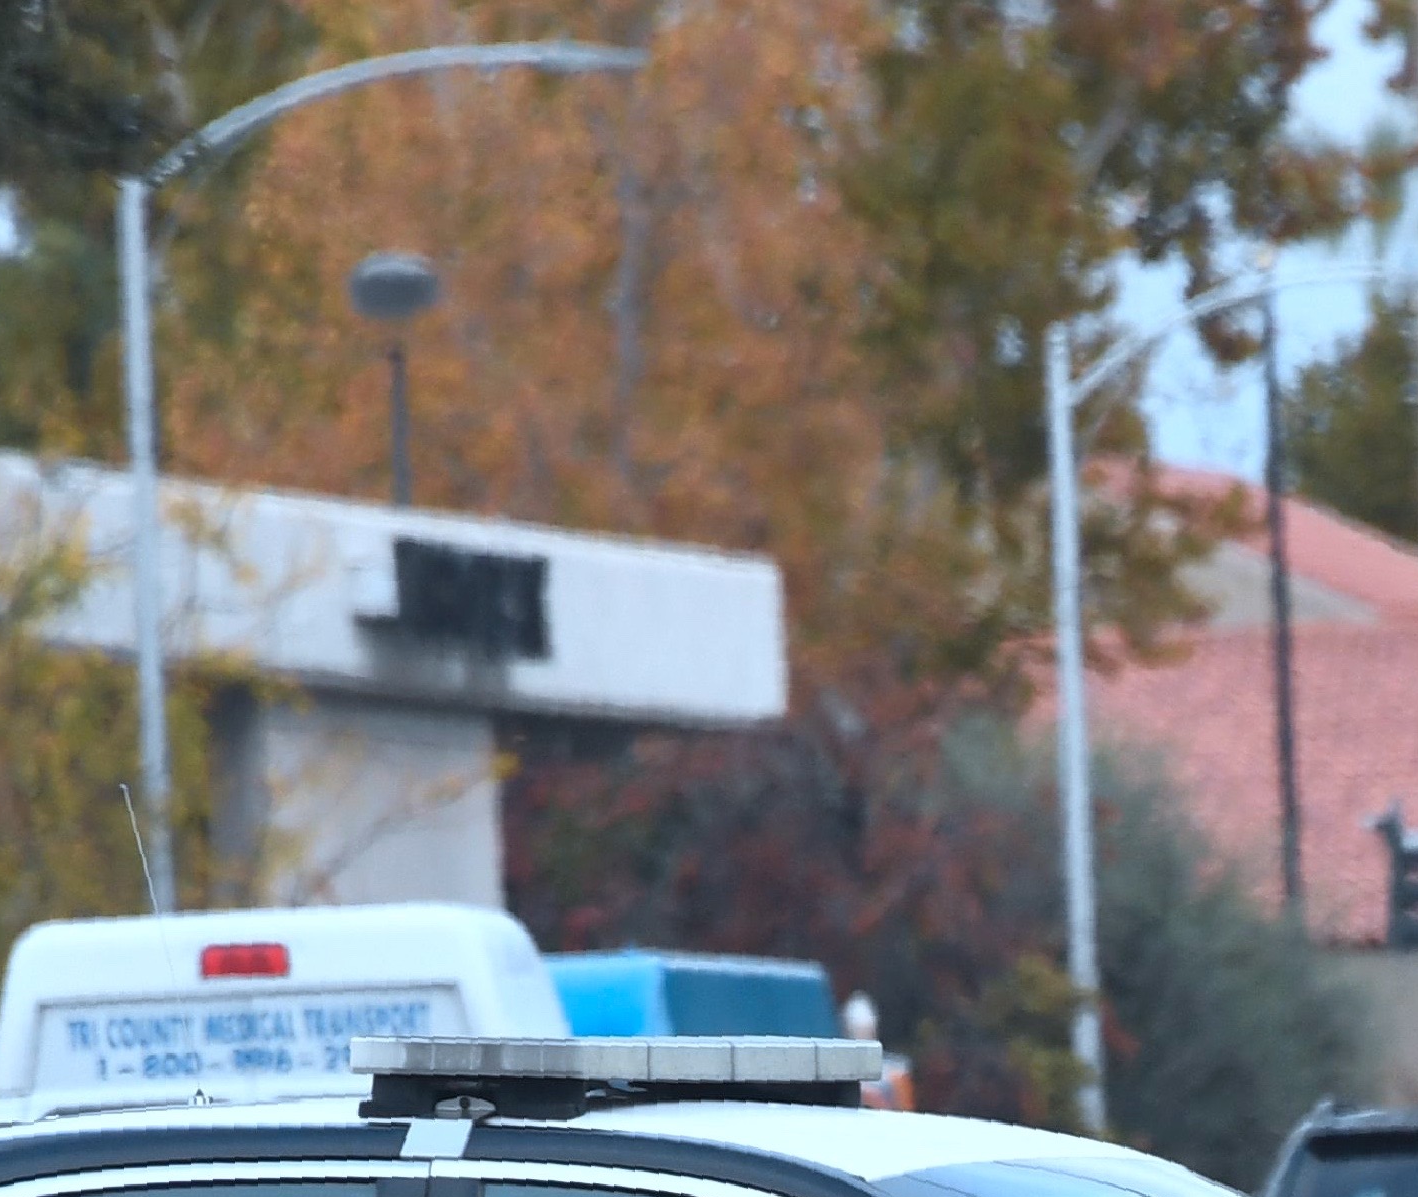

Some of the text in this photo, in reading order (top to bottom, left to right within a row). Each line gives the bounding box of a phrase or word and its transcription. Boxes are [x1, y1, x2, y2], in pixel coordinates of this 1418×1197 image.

[107, 1015, 194, 1048] COUNTY
[206, 1010, 293, 1044] MEDICAL
[303, 1002, 429, 1038] TRANSPORT
